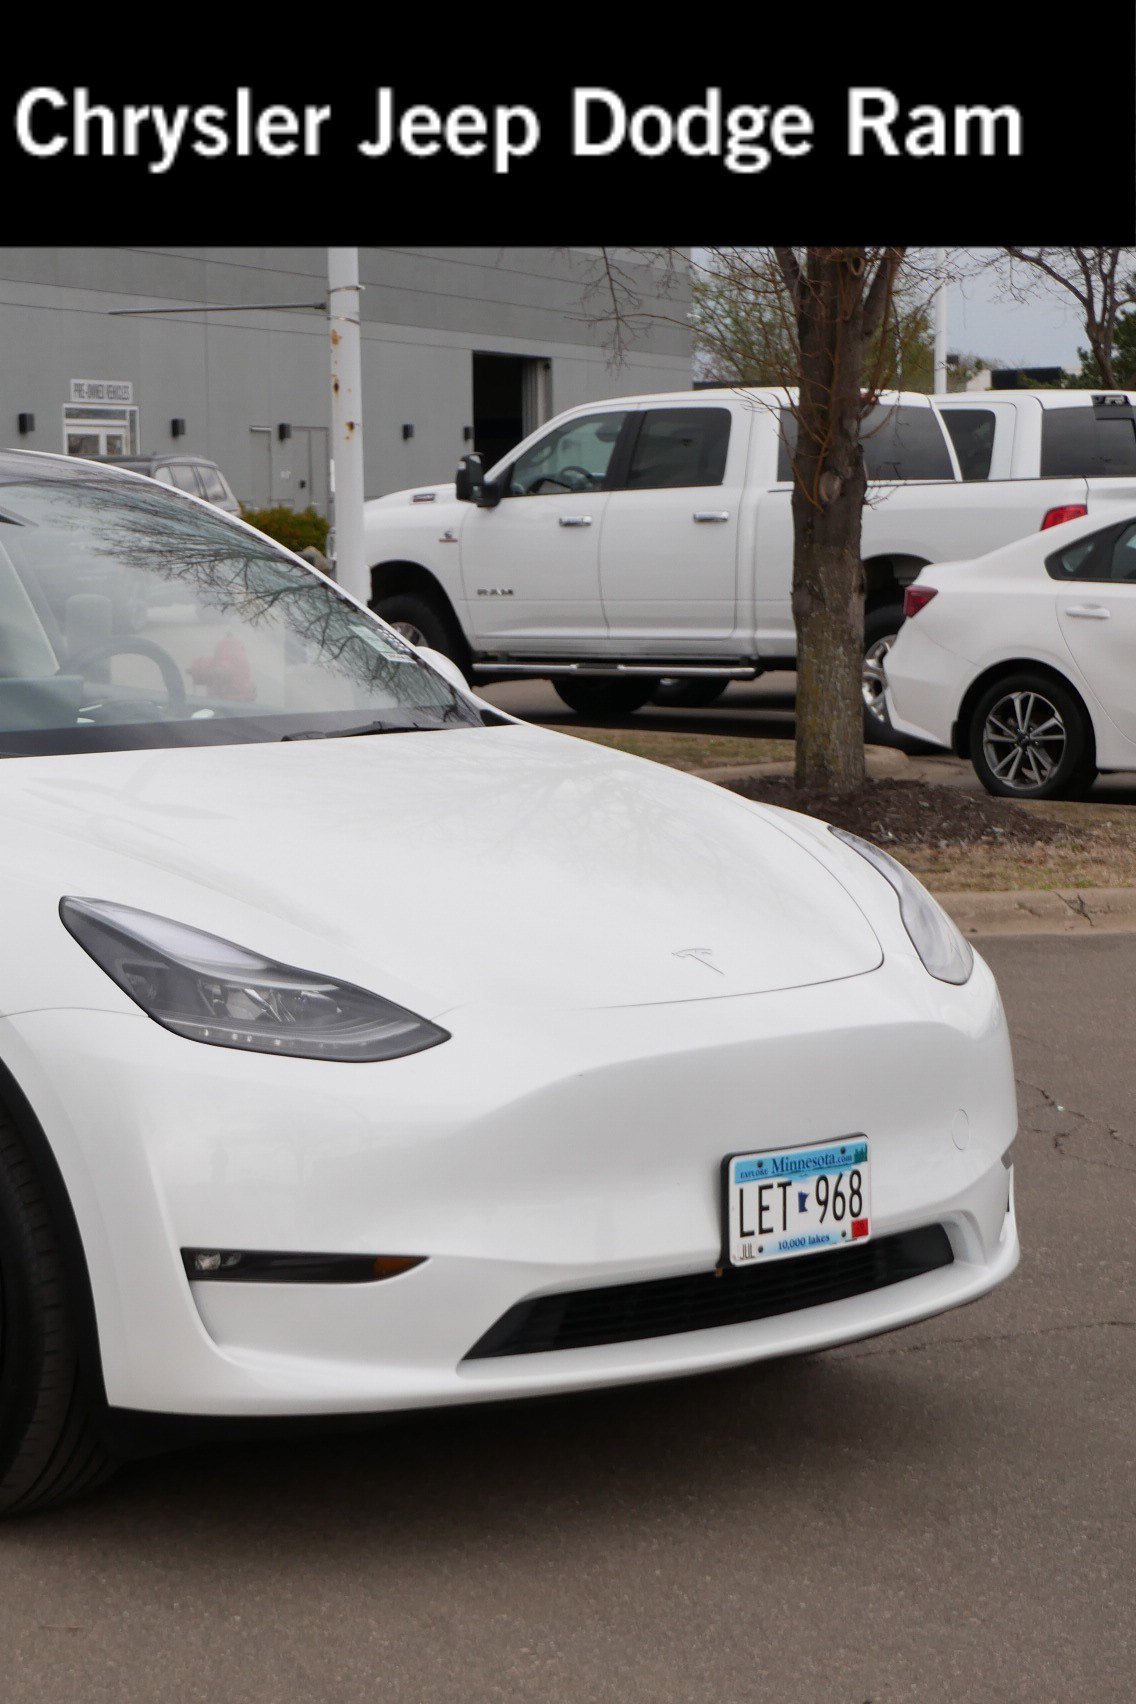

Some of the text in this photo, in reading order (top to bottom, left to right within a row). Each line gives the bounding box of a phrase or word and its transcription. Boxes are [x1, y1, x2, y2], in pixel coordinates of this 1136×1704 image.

[739, 1168, 863, 1238] LET 968
[777, 1235, 807, 1251] 10,000
[808, 1232, 831, 1246] lakes
